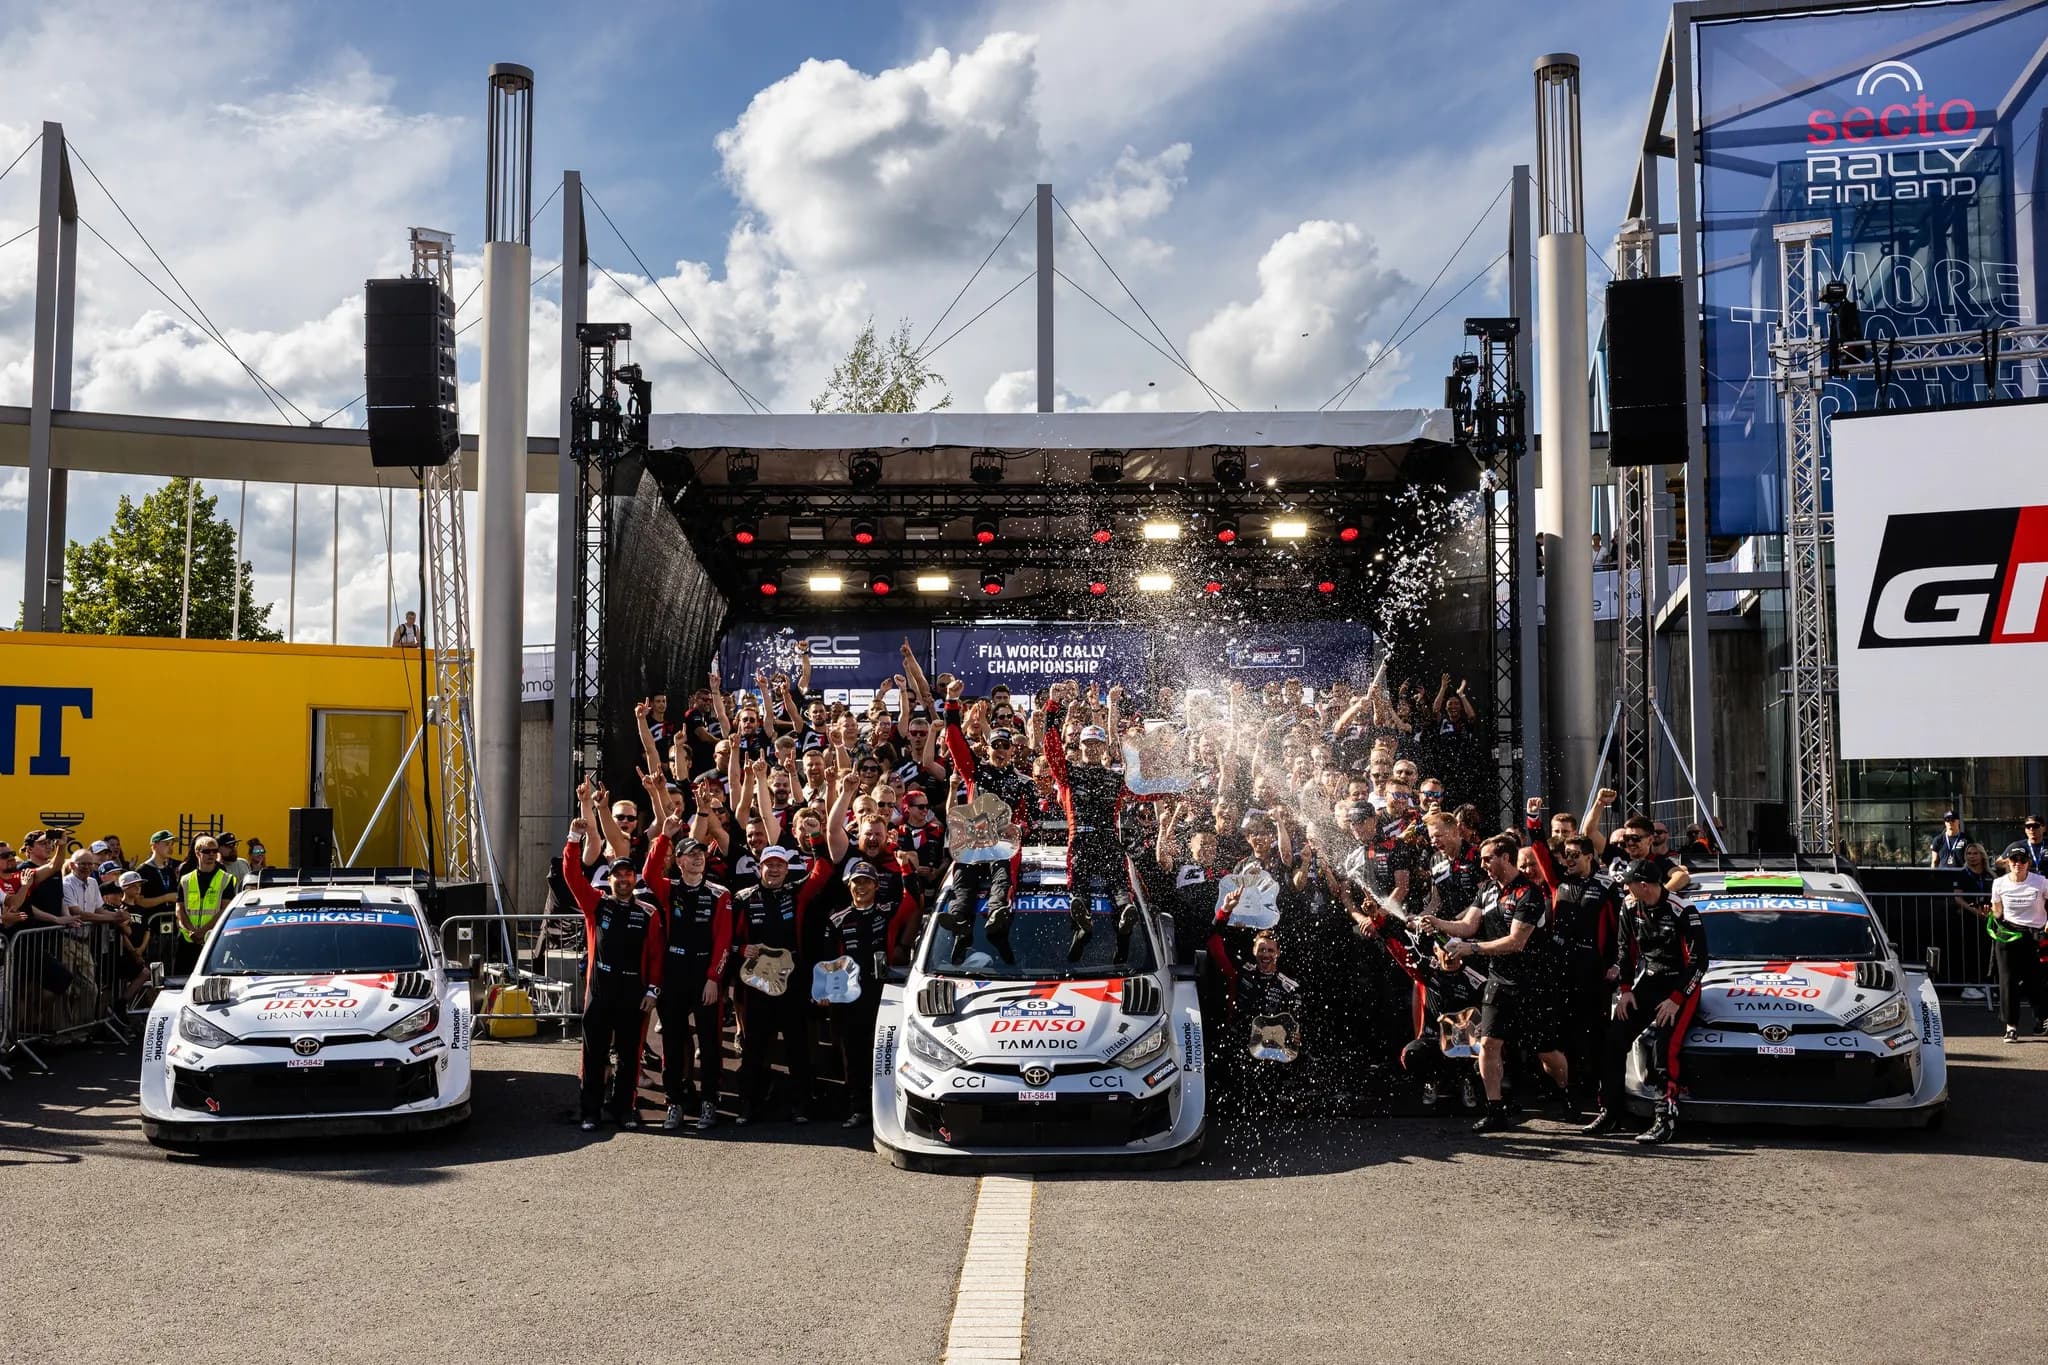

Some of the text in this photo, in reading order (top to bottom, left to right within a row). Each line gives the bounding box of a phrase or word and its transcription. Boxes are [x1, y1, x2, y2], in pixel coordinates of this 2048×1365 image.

[1807, 94, 1976, 145] secto
[1811, 247, 2032, 318] MORE
[979, 645, 1107, 658] FIA WORLD RALLY
[987, 660, 1099, 674] CHAMPIONSHIP
[1705, 900, 1829, 911] AsahiKASEI
[261, 912, 383, 924] AsahiKASEI
[1726, 987, 1822, 998] DENSO
[263, 999, 358, 1010] DENSO
[1734, 1002, 1816, 1012] TAMADIC
[450, 1008, 460, 1049] Panasonic
[989, 1019, 1087, 1033] DENSO
[154, 1016, 169, 1060] Panasonic
[997, 1040, 1079, 1049] TAMADIC
[884, 1025, 897, 1075] Panasonic
[1182, 1022, 1193, 1072] Panasonic
[1019, 1092, 1055, 1100] NT-5841
